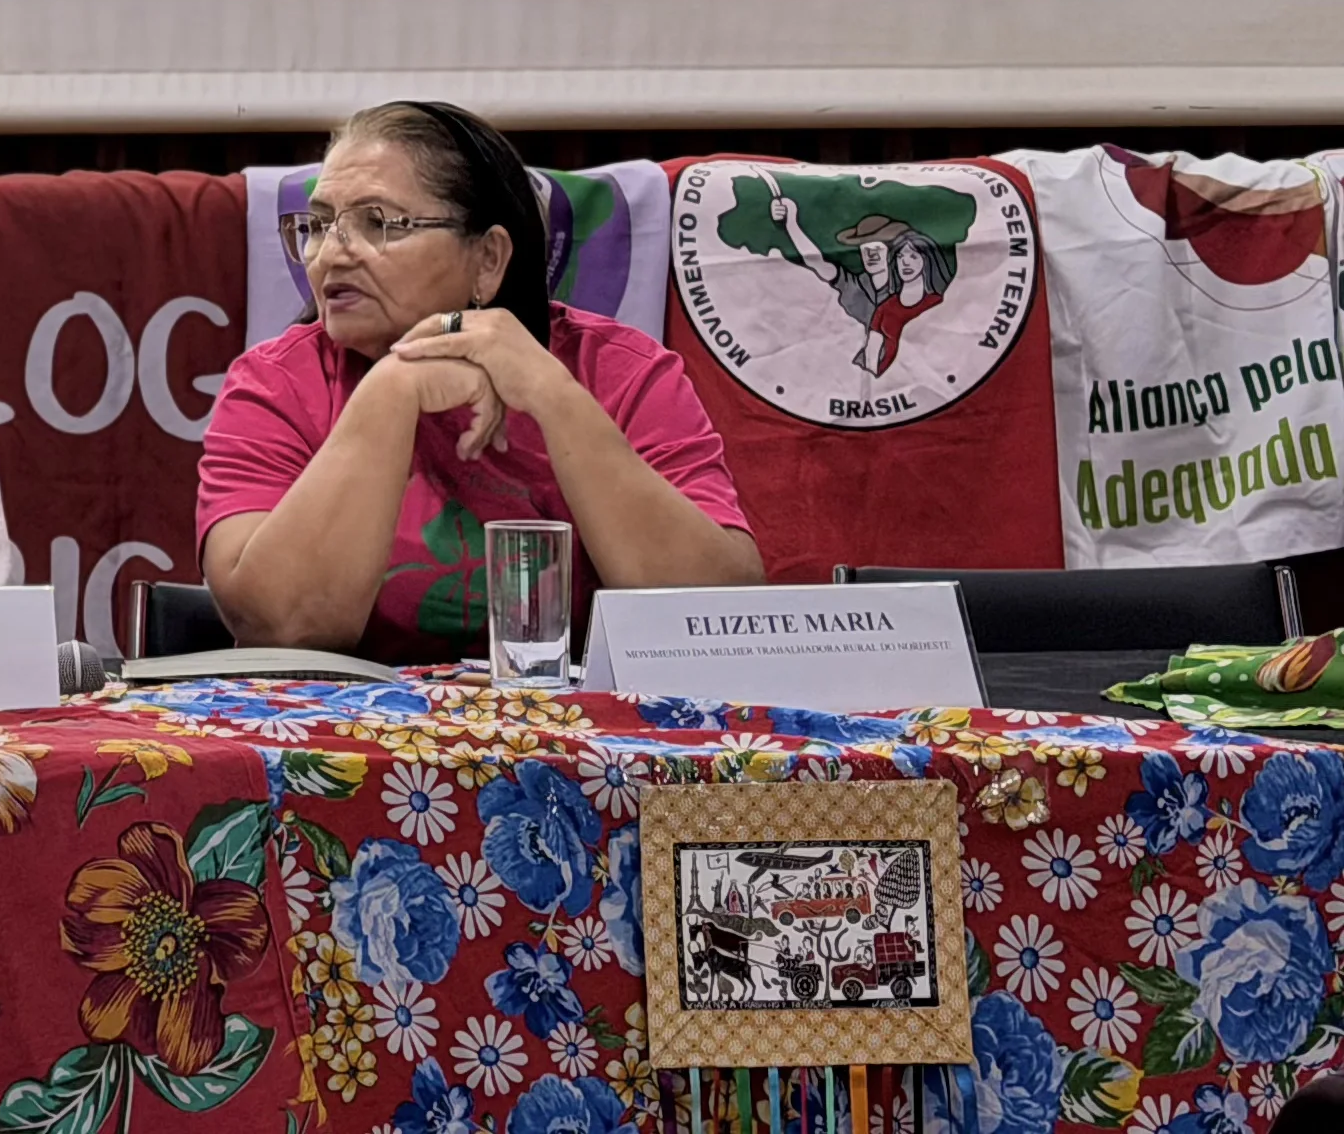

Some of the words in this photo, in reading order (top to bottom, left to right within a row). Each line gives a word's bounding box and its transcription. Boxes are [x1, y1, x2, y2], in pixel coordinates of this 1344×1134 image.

[683, 169, 712, 205] DOS
[1001, 204, 1028, 258] SEM
[678, 212, 752, 368] MOVIMENTO
[978, 266, 1027, 350] TERRA
[829, 392, 918, 419] BRASIL
[1088, 371, 1231, 434] Aliança
[1240, 338, 1337, 413] pela
[1076, 417, 1338, 530] Adequada
[625, 647, 690, 660] MOVIMENTO
[692, 648, 709, 658] DA
[710, 645, 754, 658] MULHER
[756, 644, 842, 656] TRABALHADORA
[843, 642, 878, 653] RURAL
[880, 642, 897, 652] DO
[898, 640, 953, 652] NORDESTE
[685, 614, 800, 637] ELIZETE
[805, 611, 895, 633] MARIA
